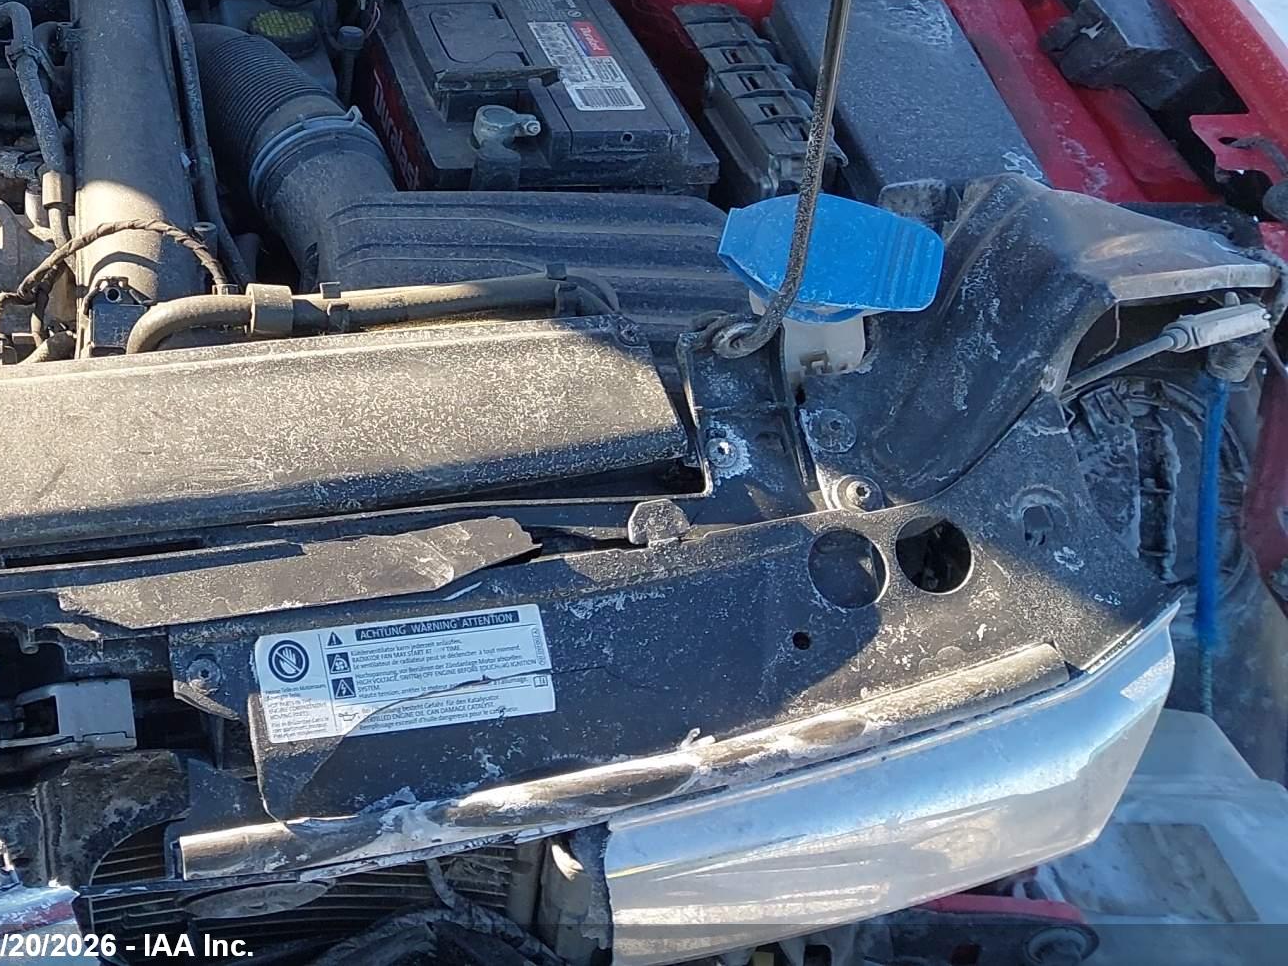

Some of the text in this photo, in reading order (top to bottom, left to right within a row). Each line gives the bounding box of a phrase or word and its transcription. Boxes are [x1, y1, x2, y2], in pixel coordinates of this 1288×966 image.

[373, 68, 420, 190] Duralast
[360, 613, 513, 640] ACHTUNG WARNING ATTENTION
[511, 658, 536, 667] IGNITION
[440, 705, 465, 713] DAMAGE
